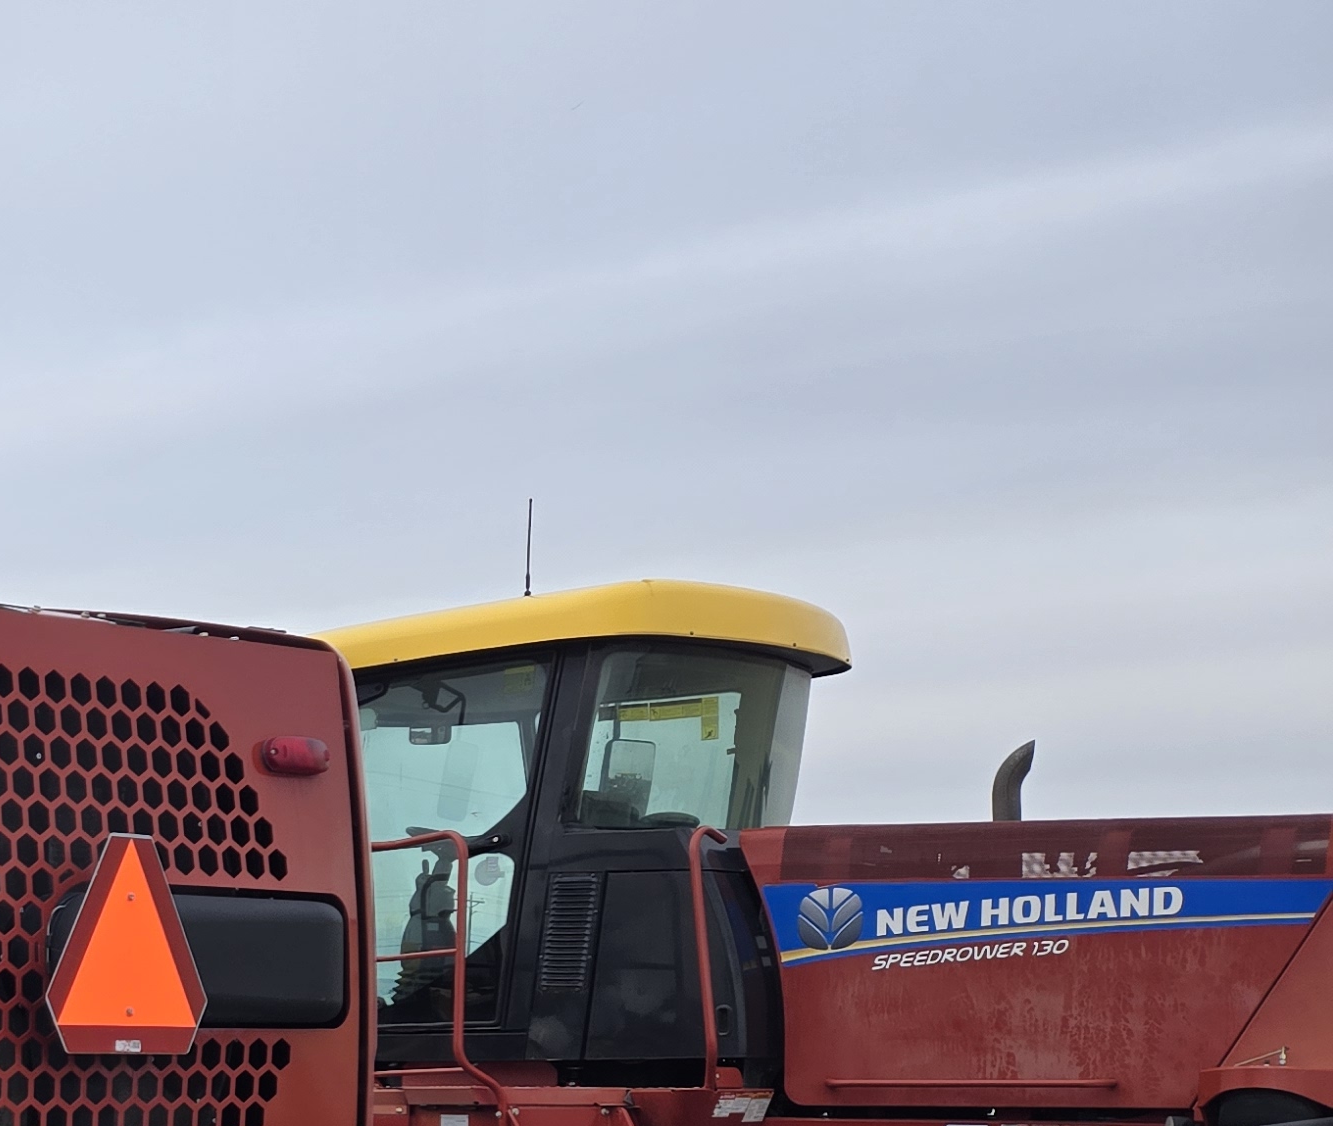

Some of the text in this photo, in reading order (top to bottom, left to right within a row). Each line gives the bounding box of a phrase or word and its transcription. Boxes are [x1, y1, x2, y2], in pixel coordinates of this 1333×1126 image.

[876, 886, 1184, 937] NEW HOLLAND
[871, 939, 1070, 971] SPEEDROWER 130
